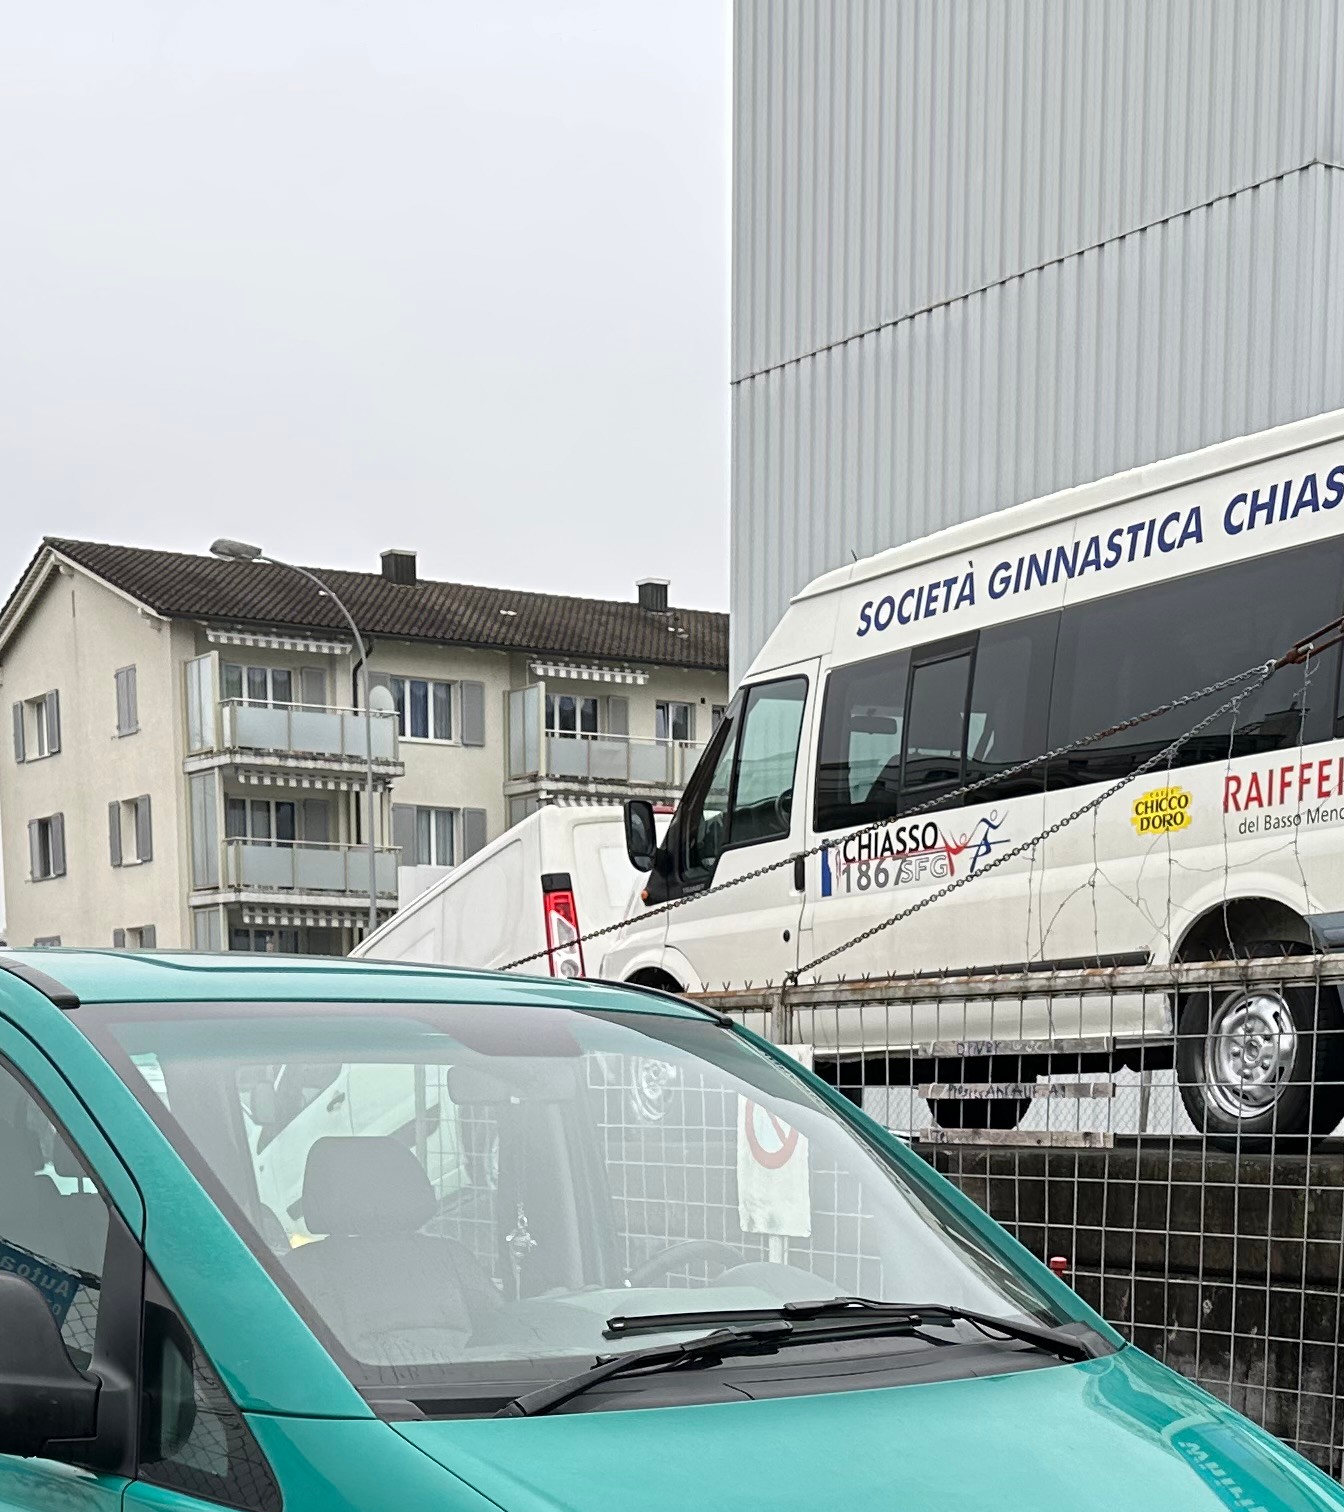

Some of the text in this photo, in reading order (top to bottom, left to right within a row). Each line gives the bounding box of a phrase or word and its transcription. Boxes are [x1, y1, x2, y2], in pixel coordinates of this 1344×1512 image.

[856, 560, 977, 637] SOCIETÀ
[988, 505, 1204, 600] GINNASTICA
[1135, 794, 1189, 816] CHICCO
[843, 821, 938, 864] CHIASSO
[1238, 815, 1259, 835] del
[1264, 814, 1302, 831] Basso
[841, 855, 907, 893] 1867
